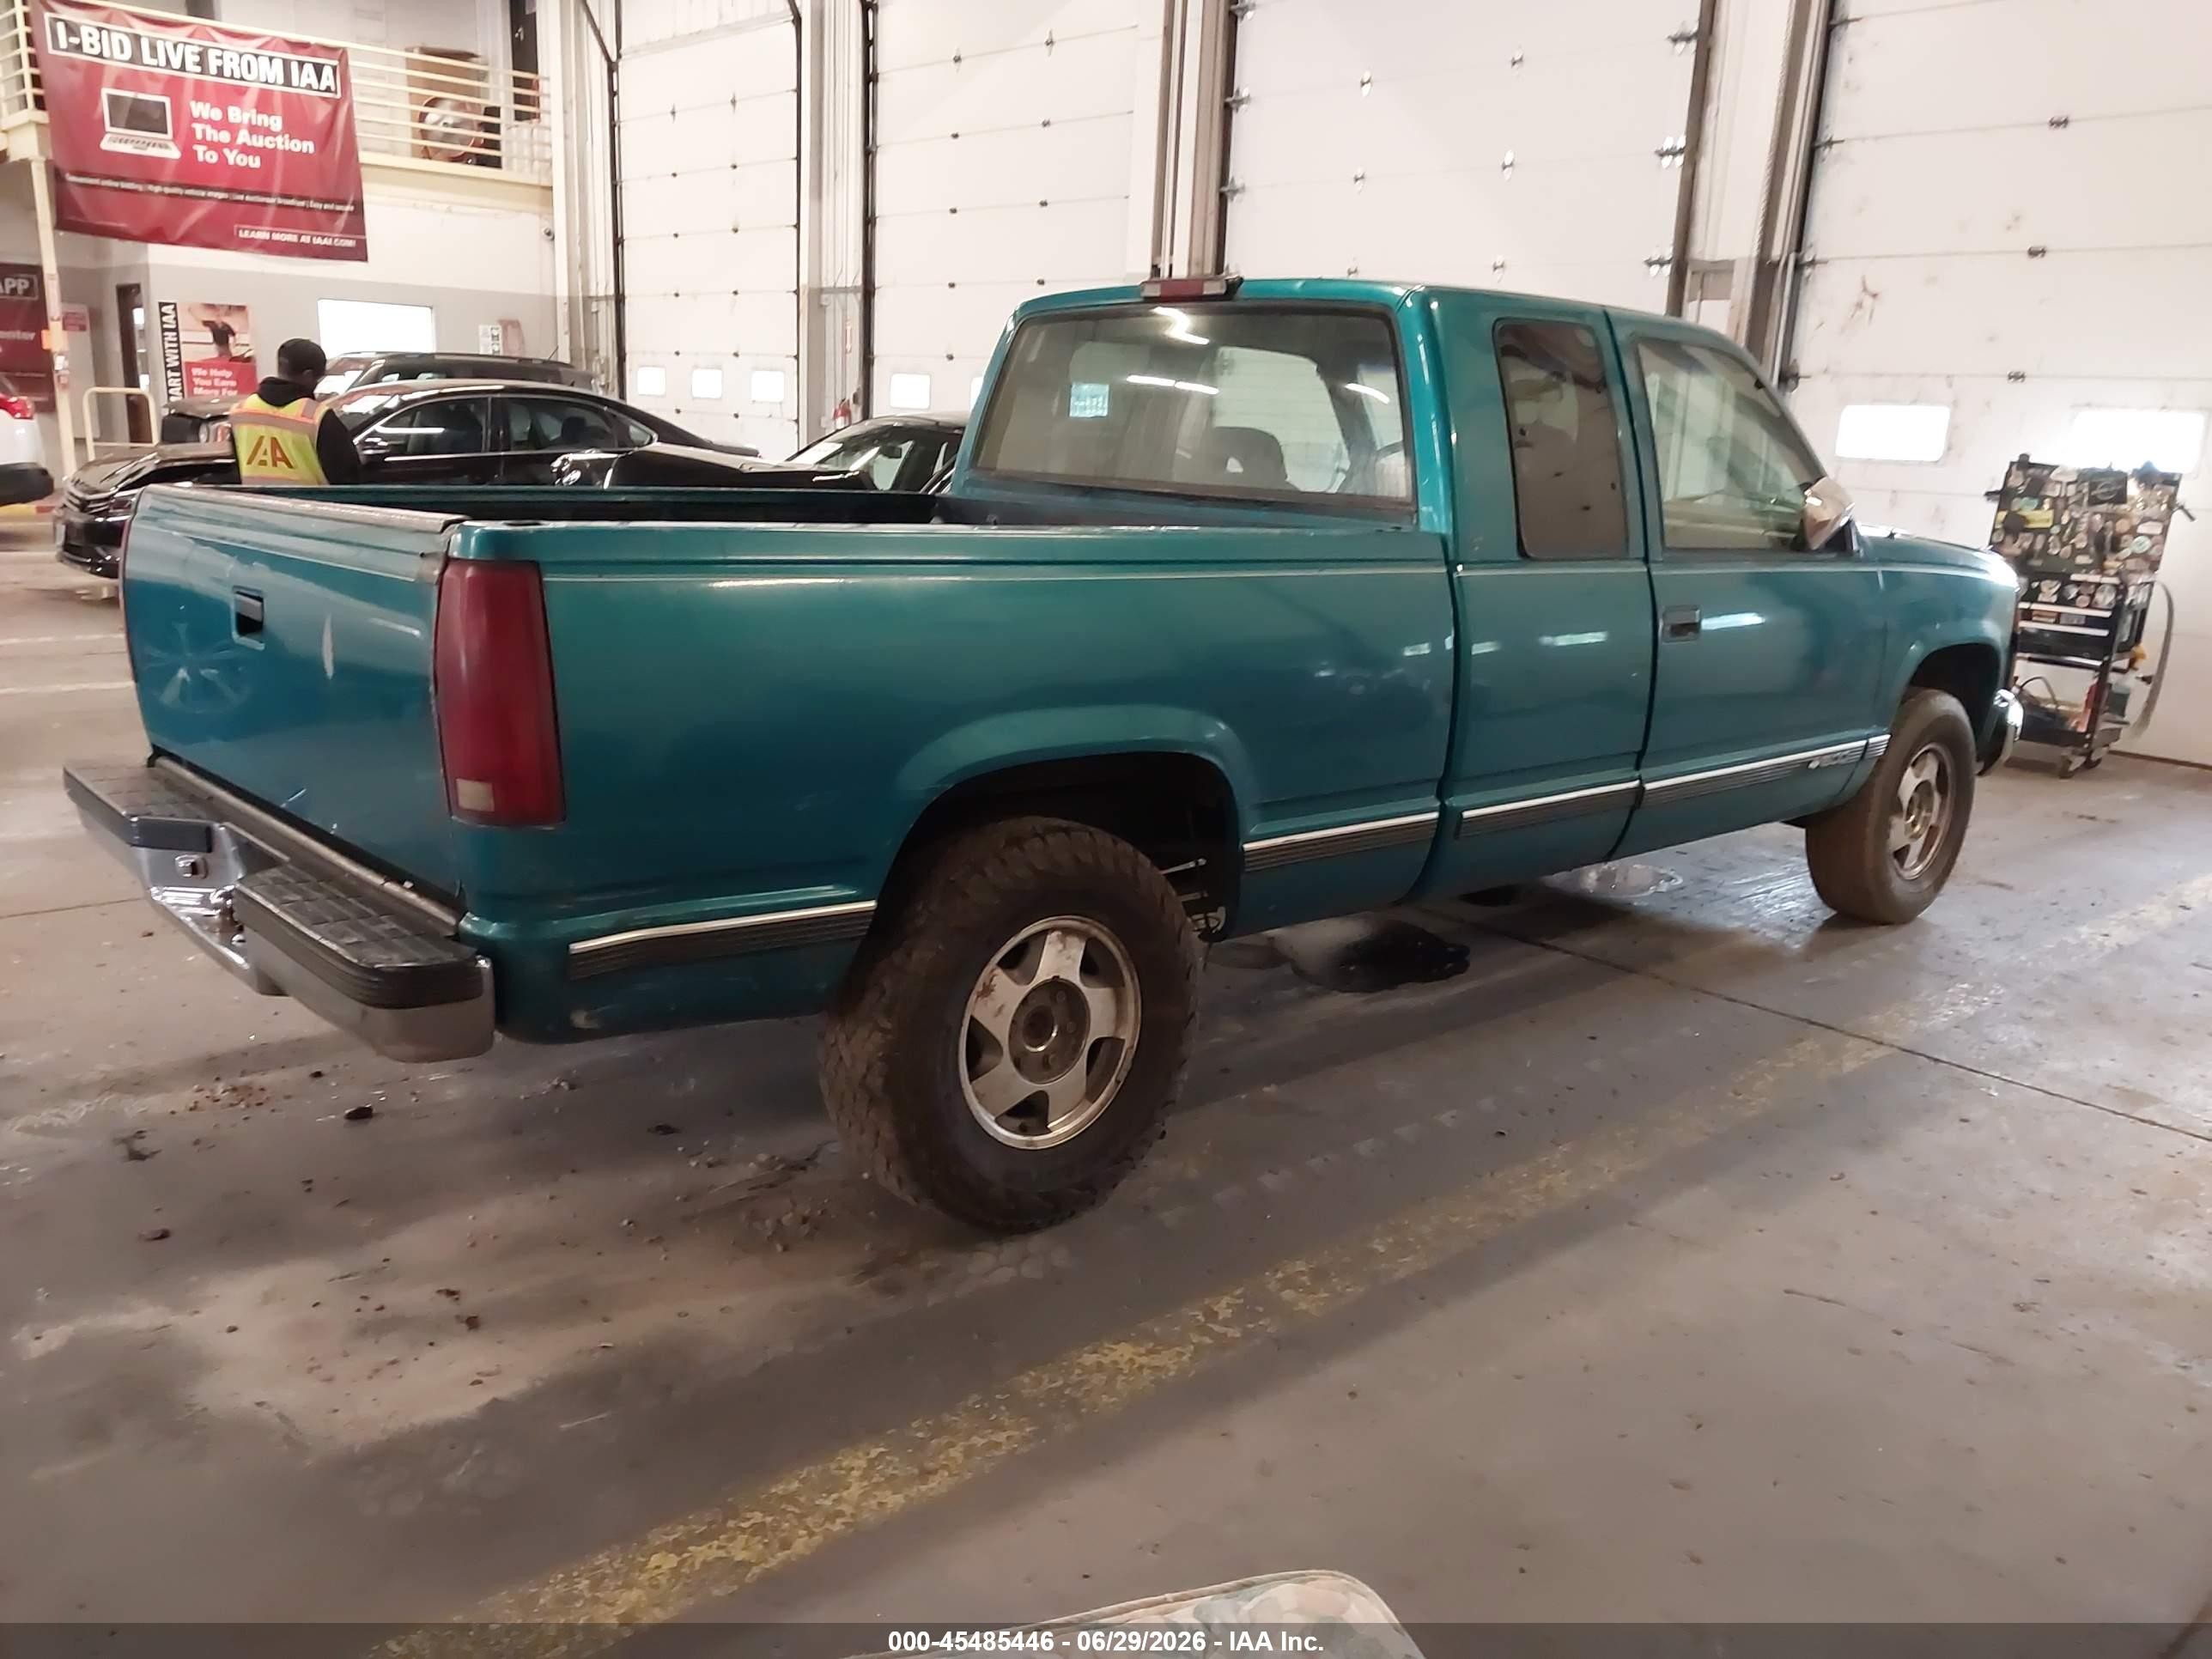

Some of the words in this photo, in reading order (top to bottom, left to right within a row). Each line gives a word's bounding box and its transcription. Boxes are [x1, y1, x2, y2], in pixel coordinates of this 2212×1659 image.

[56, 21, 132, 61] I-BID
[140, 35, 203, 73] LIVE
[207, 47, 284, 85] FROM
[289, 60, 336, 92] IAA
[190, 100, 223, 121] We
[227, 106, 283, 132] Bring
[191, 123, 231, 143] The
[236, 128, 315, 155] Auction
[192, 144, 219, 163] To
[222, 148, 261, 168] You
[161, 304, 177, 329] IAA
[162, 331, 180, 368] WITH
